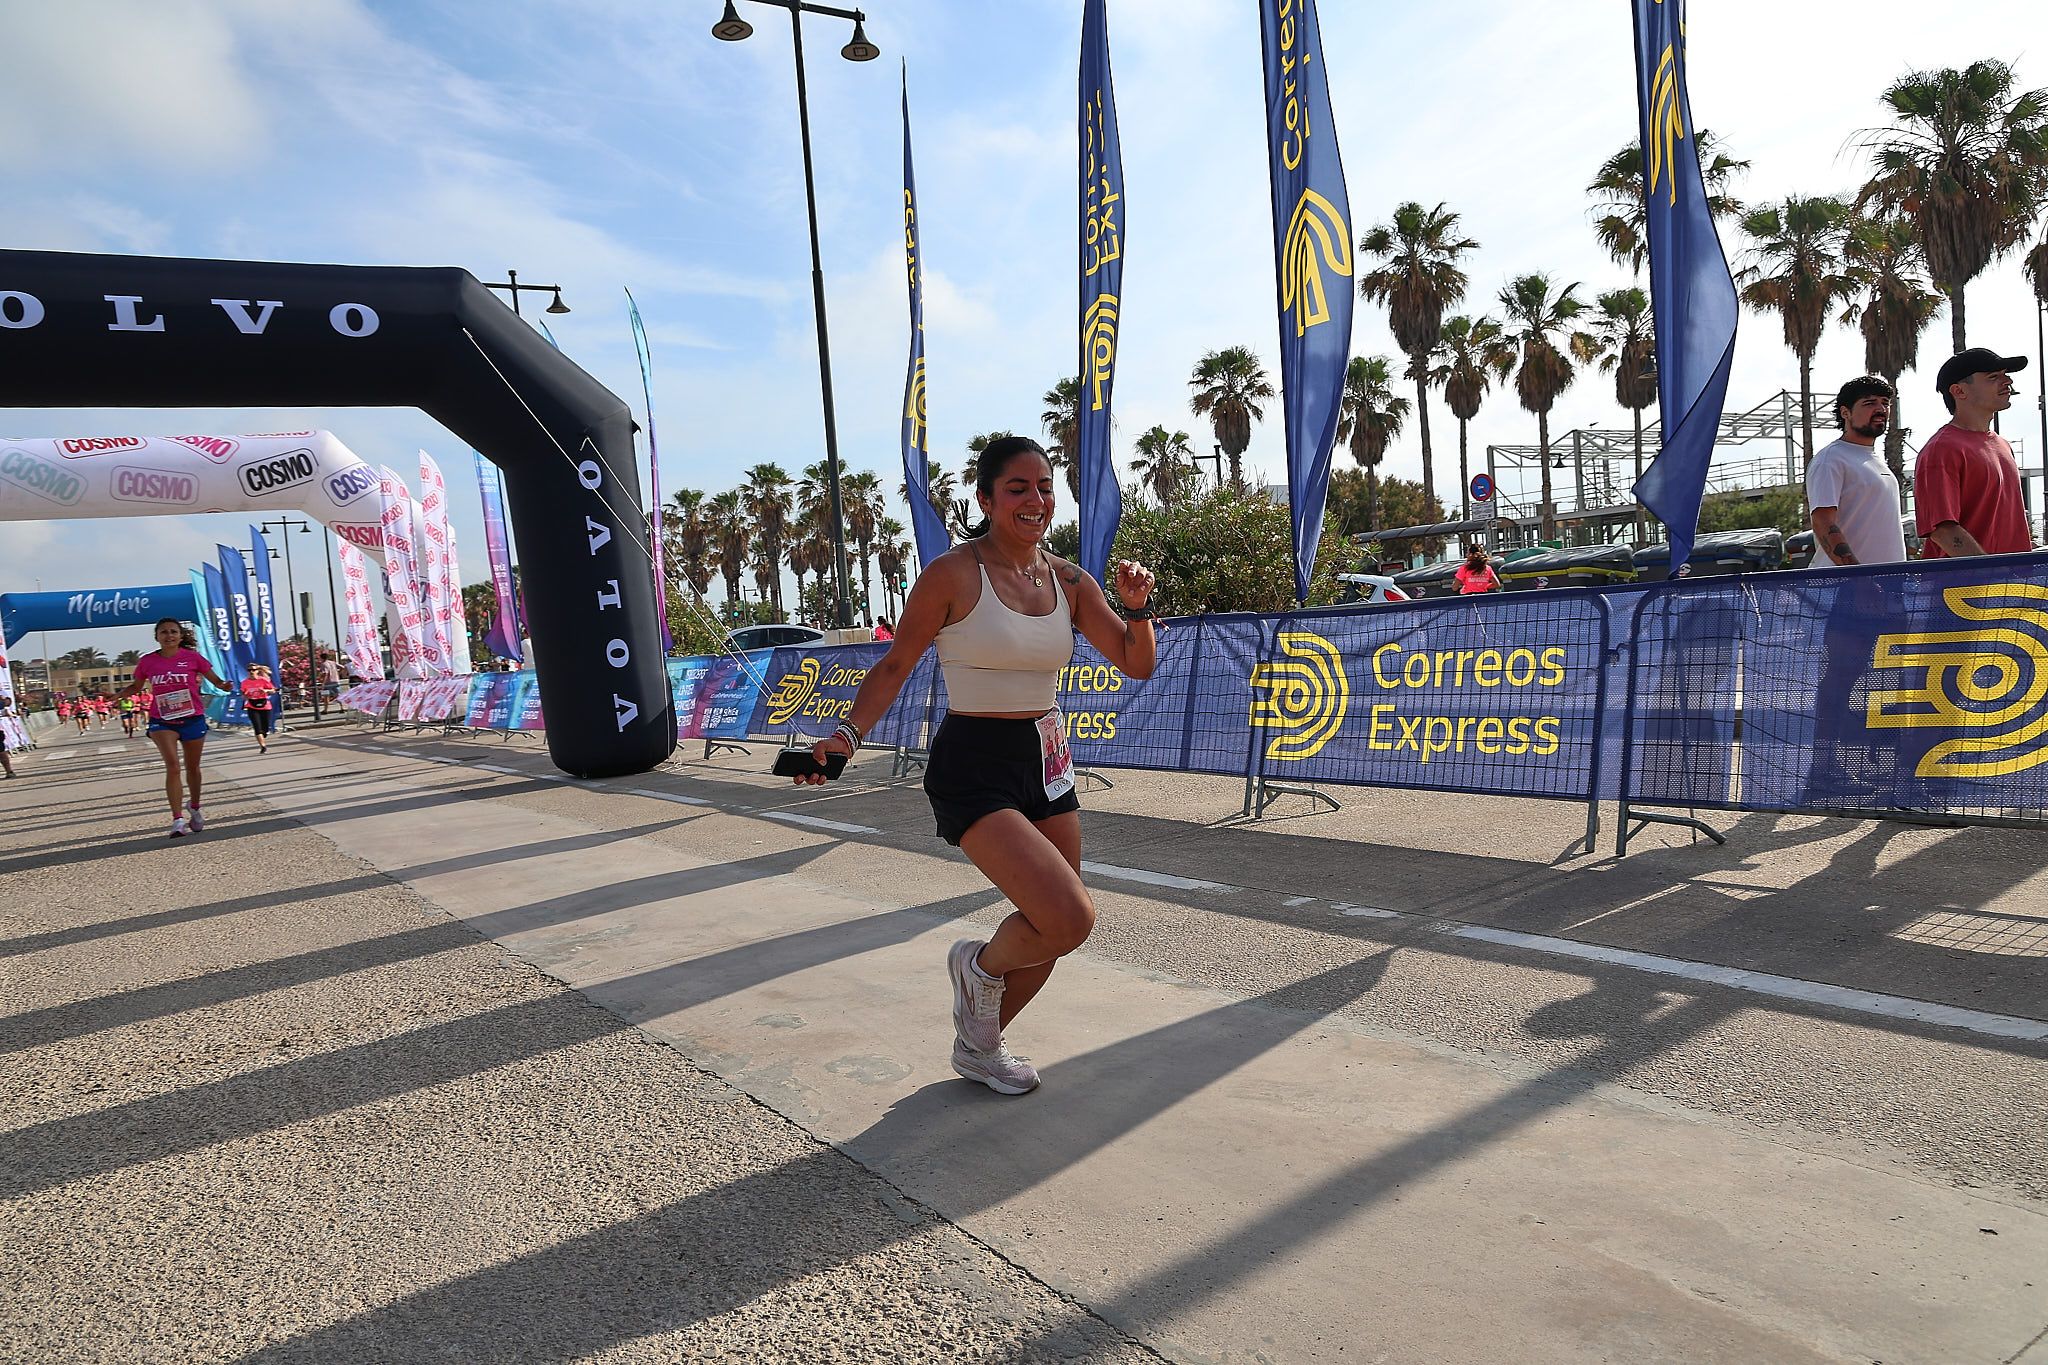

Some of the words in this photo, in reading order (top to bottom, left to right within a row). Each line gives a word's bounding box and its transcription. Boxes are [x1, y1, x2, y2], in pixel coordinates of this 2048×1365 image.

[1279, 0, 1303, 171] Correo
[0, 290, 380, 337] OLVO
[175, 436, 232, 457] SMO
[0, 451, 80, 501] COSMO
[118, 470, 192, 501] COSMO
[245, 452, 313, 492] COSMO
[330, 465, 380, 501] COSM
[336, 525, 384, 547] COSM
[68, 591, 150, 623] Marlene
[578, 460, 639, 732] VOLVO
[821, 663, 869, 686] Corre
[1057, 664, 1122, 692] rreos
[1371, 641, 1566, 689] Correos
[802, 692, 854, 724] Expre
[1066, 711, 1117, 740] ress
[1368, 703, 1561, 765] Express
